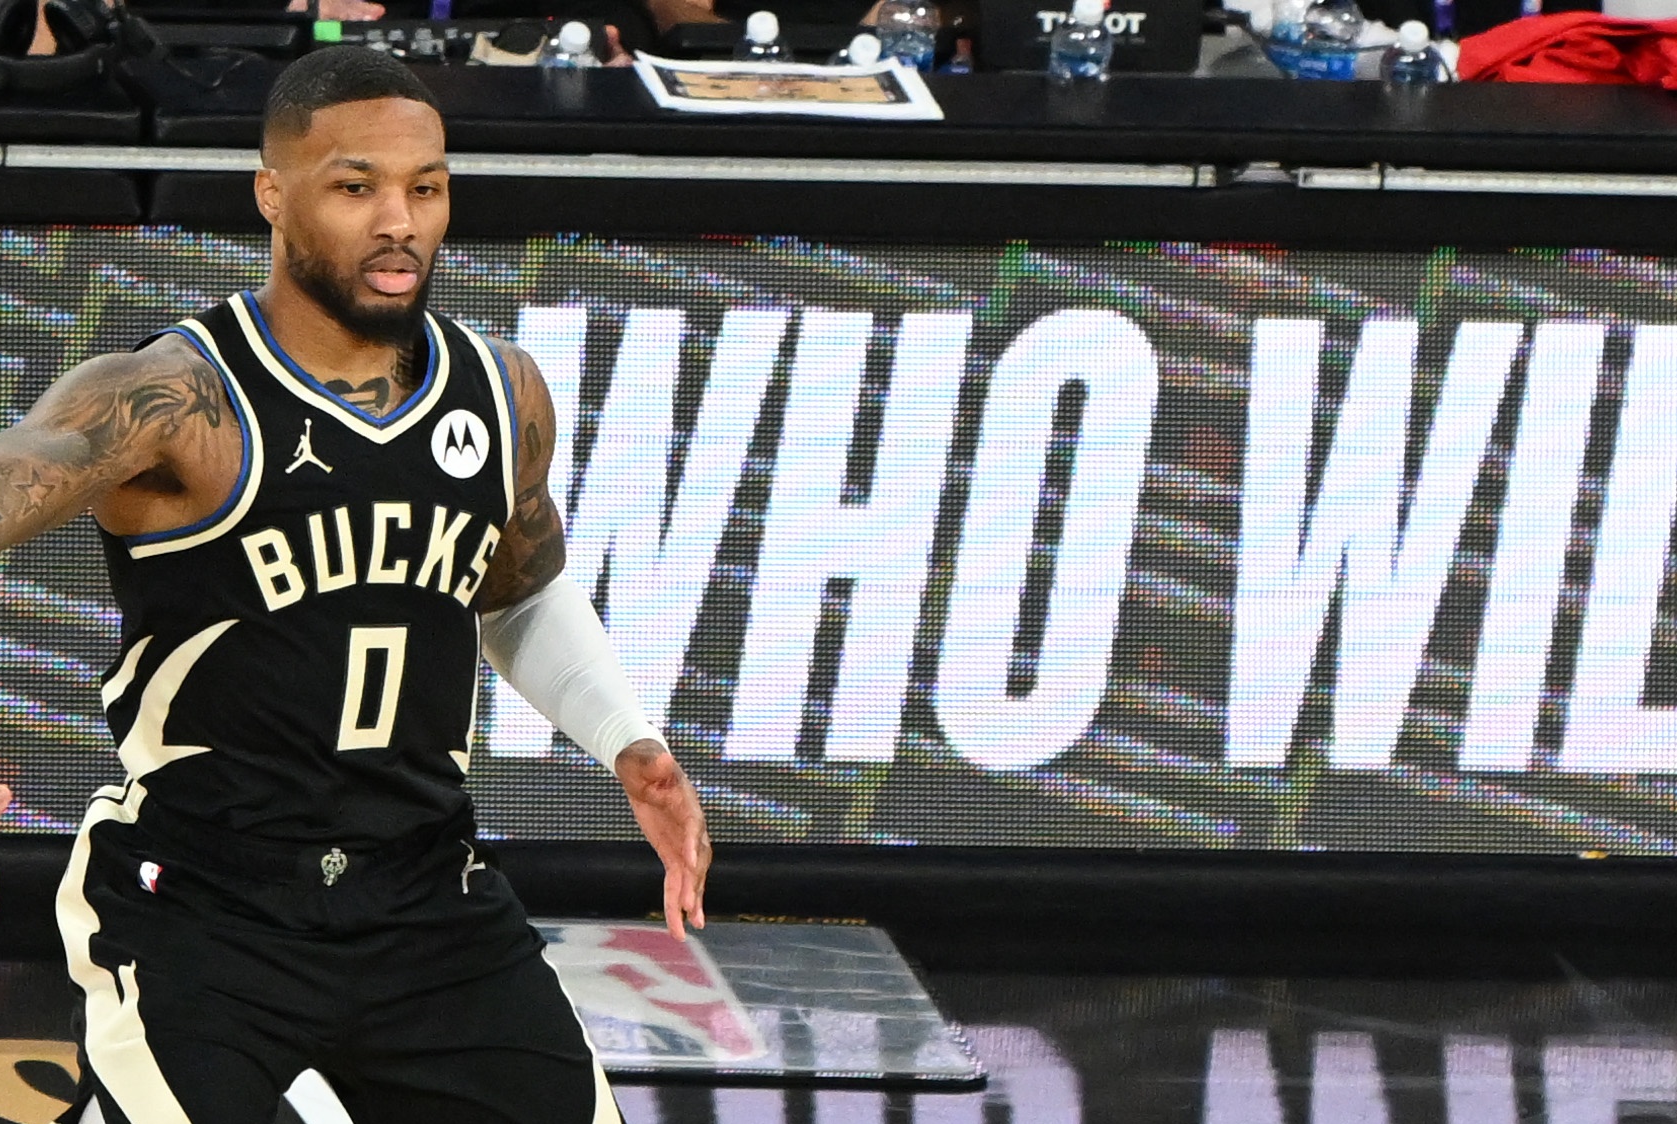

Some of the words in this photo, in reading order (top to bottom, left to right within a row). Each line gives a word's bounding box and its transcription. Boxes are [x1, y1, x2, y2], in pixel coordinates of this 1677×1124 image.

[240, 501, 502, 613] BUCKS
[487, 307, 1159, 773] WHO
[336, 624, 410, 752] 0
